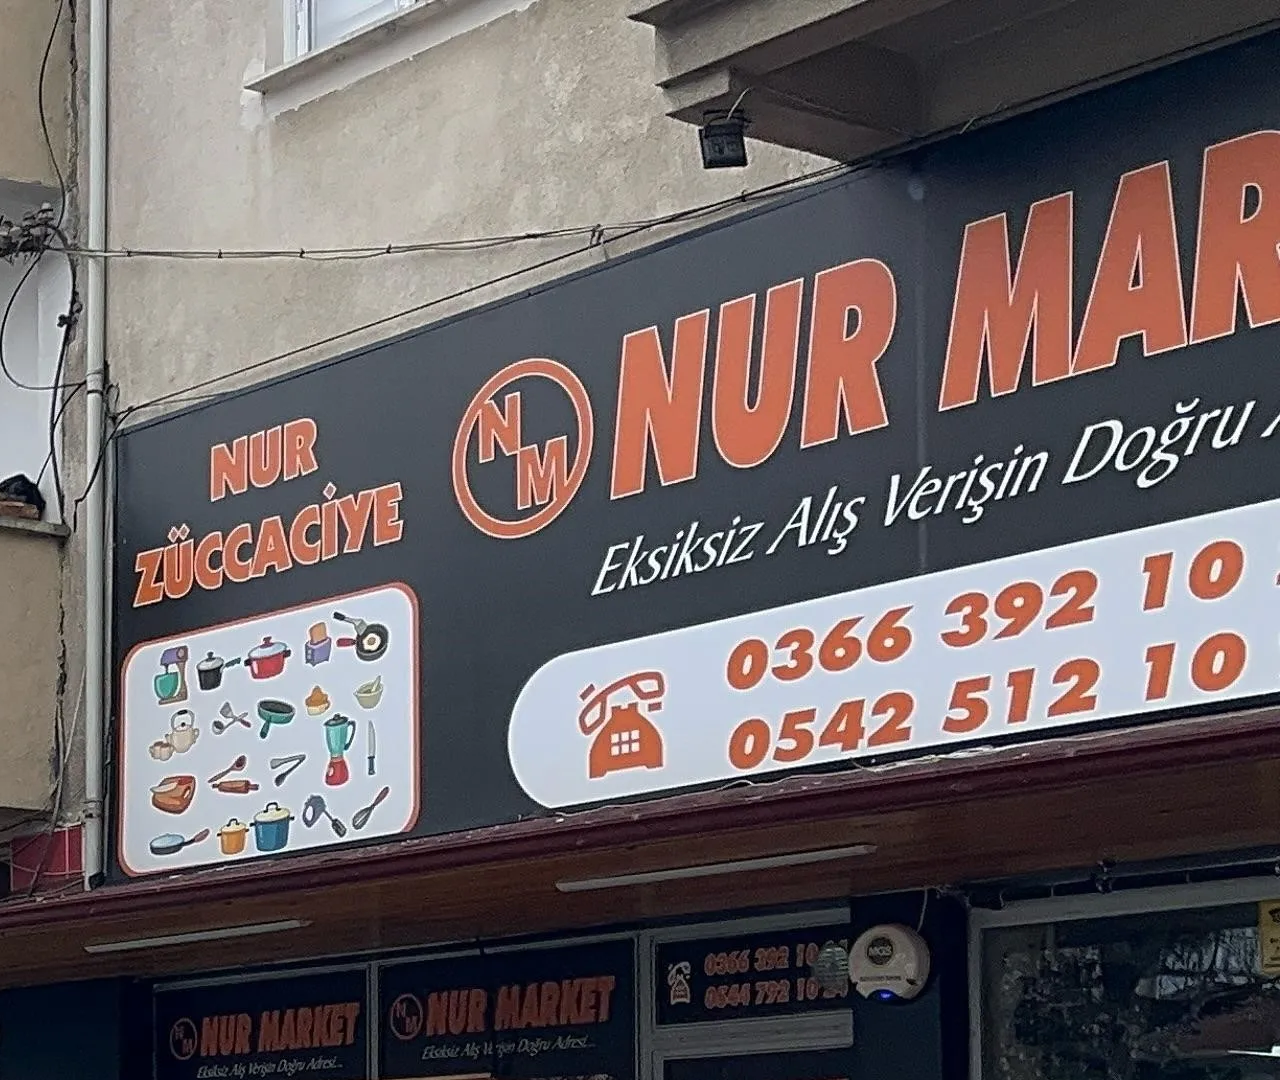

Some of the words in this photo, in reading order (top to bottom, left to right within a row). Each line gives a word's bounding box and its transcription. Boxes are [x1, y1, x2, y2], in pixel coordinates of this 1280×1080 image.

[610, 257, 897, 499] NUR
[210, 417, 318, 501] NUR
[591, 517, 761, 597] Eksiksiz
[766, 487, 864, 555] Alış
[883, 446, 1049, 528] Verişin
[1061, 399, 1255, 488] Doğru
[133, 482, 404, 607] ZÜCCACİYE
[727, 607, 913, 691] 0366
[941, 569, 1100, 649] 392
[1141, 539, 1246, 611] 10
[728, 691, 915, 770] 0542
[942, 658, 1102, 733] 512
[1144, 632, 1248, 701] 10
[426, 988, 488, 1036] NUR
[493, 975, 616, 1031] MARKET
[704, 949, 750, 976] 0366
[754, 945, 789, 972] 392
[796, 942, 820, 967] 10
[755, 979, 790, 1005] 792
[796, 977, 820, 1001] 10
[200, 1013, 252, 1056] NUR
[257, 1002, 360, 1053] MARKET
